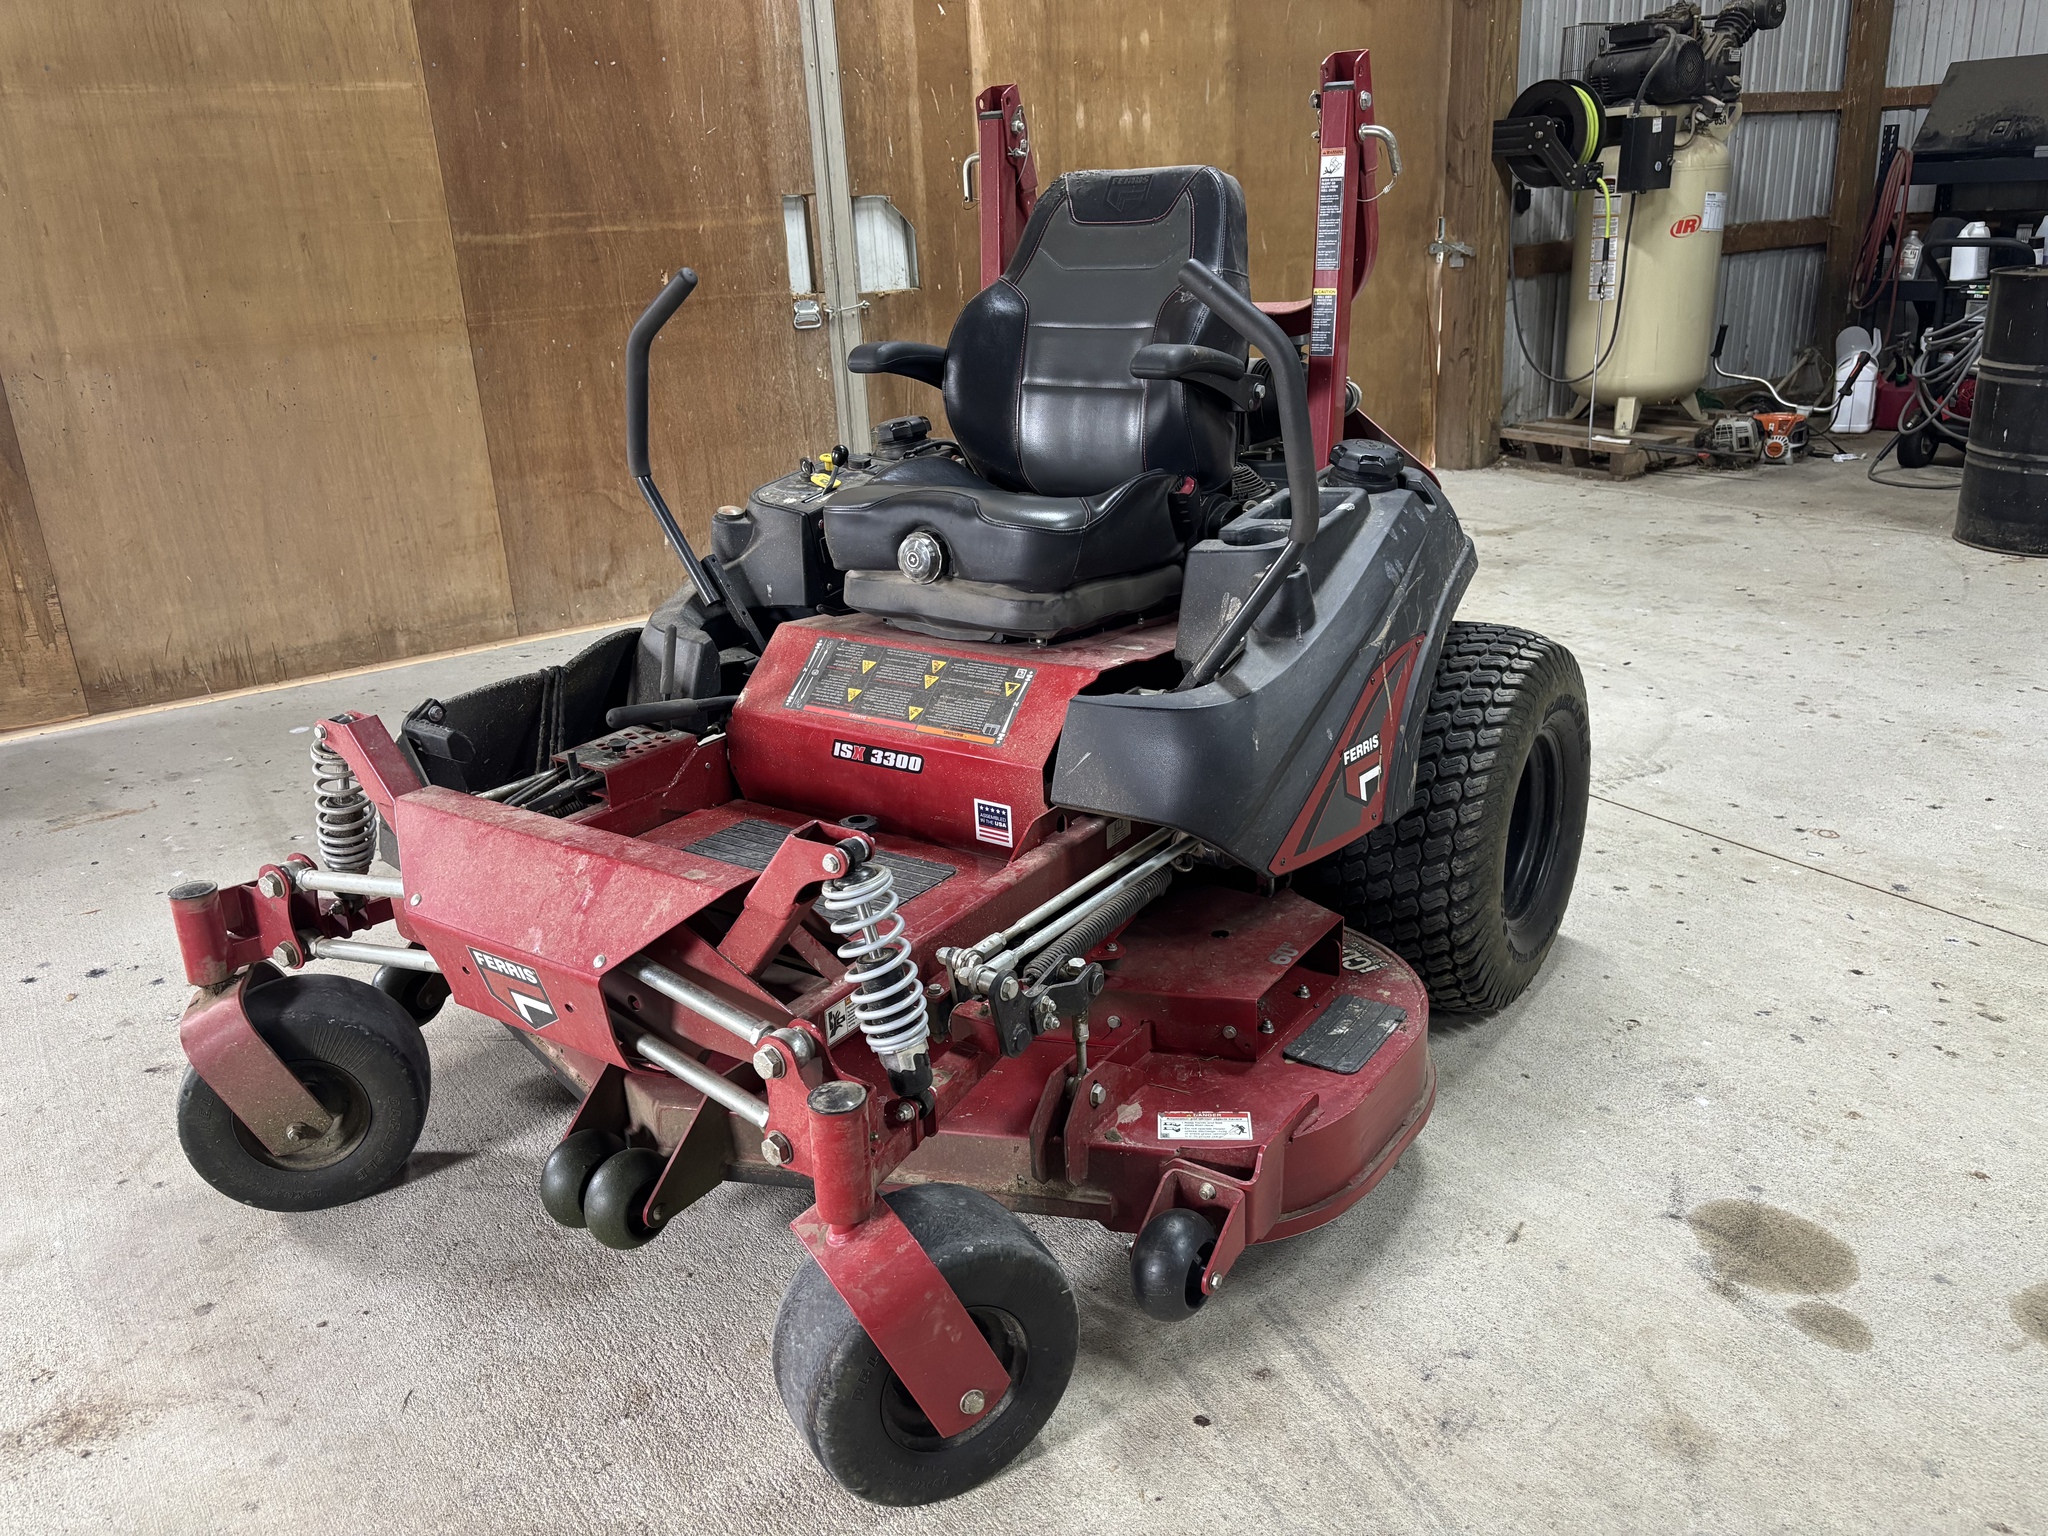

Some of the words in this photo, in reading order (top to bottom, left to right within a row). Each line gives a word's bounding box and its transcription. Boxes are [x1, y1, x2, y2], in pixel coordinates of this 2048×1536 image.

[1112, 176, 1150, 184] FERRIS
[1675, 219, 1697, 234] IR
[943, 730, 965, 738] WARNING
[833, 742, 865, 761] ISX
[870, 749, 922, 772] 3300
[1343, 734, 1379, 766] FERRIS
[980, 812, 1007, 823] ASSEMBLED
[473, 950, 538, 984] FERRIS
